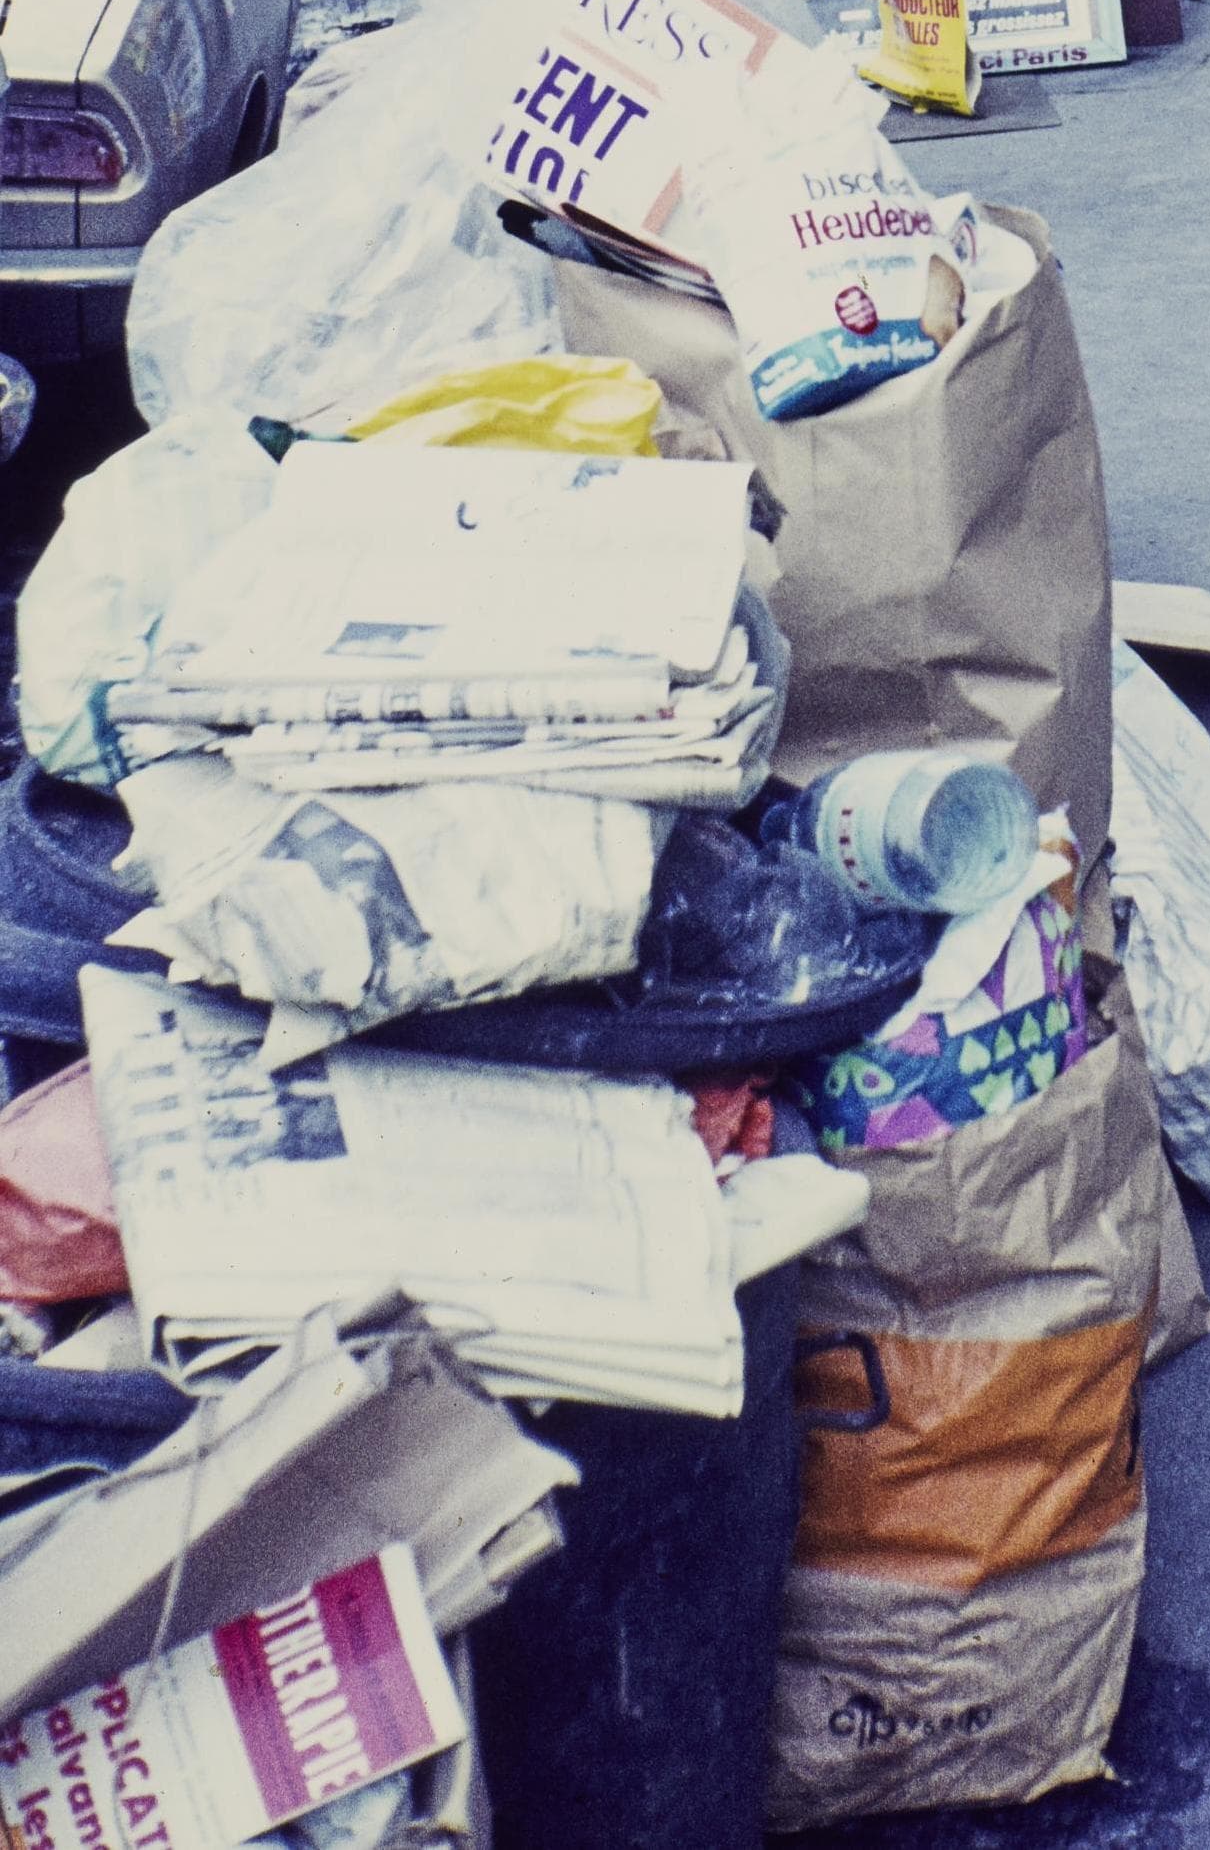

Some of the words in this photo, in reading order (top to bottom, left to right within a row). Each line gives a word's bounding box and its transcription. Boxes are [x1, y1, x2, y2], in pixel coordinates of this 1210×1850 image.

[978, 51, 1004, 71] ci
[1012, 43, 1089, 68] Paris
[789, 199, 934, 249] Heudebe
